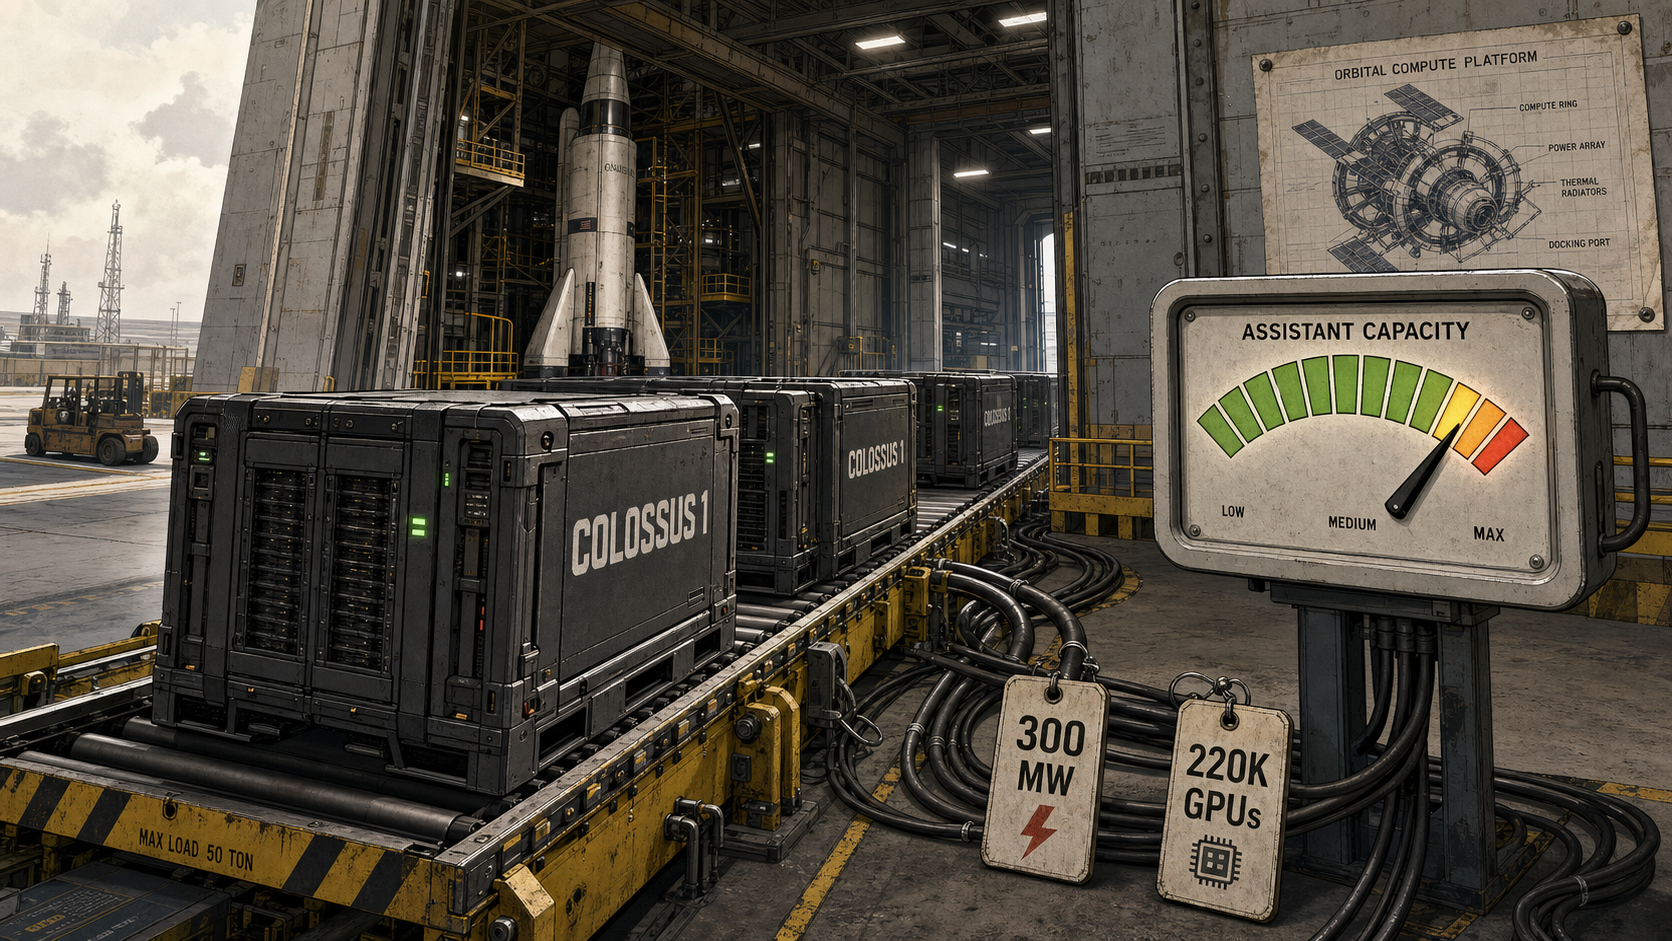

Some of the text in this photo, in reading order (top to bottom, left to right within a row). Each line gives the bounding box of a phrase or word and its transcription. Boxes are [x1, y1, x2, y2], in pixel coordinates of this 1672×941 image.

[1335, 50, 1538, 81] ORBITAL COMPUTE PLATFORM
[1519, 99, 1578, 112] COMPUTE RING
[1548, 140, 1606, 153] POWER ARRAY
[1561, 177, 1599, 188] THERMAL
[1561, 187, 1608, 198] RADIATORS
[1548, 237, 1611, 250] DOCKING PORT
[1242, 321, 1470, 341] ASSISTANT CAPACITY
[847, 440, 905, 480] COLOSSUS 1
[1221, 504, 1245, 519] LOW
[571, 489, 709, 577] COLOSSUS 1
[1328, 515, 1377, 532] MEDIUM
[1473, 525, 1505, 543] MAX
[1016, 714, 1086, 757] 300
[1186, 743, 1271, 788] 220K
[1017, 759, 1076, 797] MW
[1183, 787, 1262, 830] GPUs
[139, 828, 253, 871] MAX LOAD 50 TON
